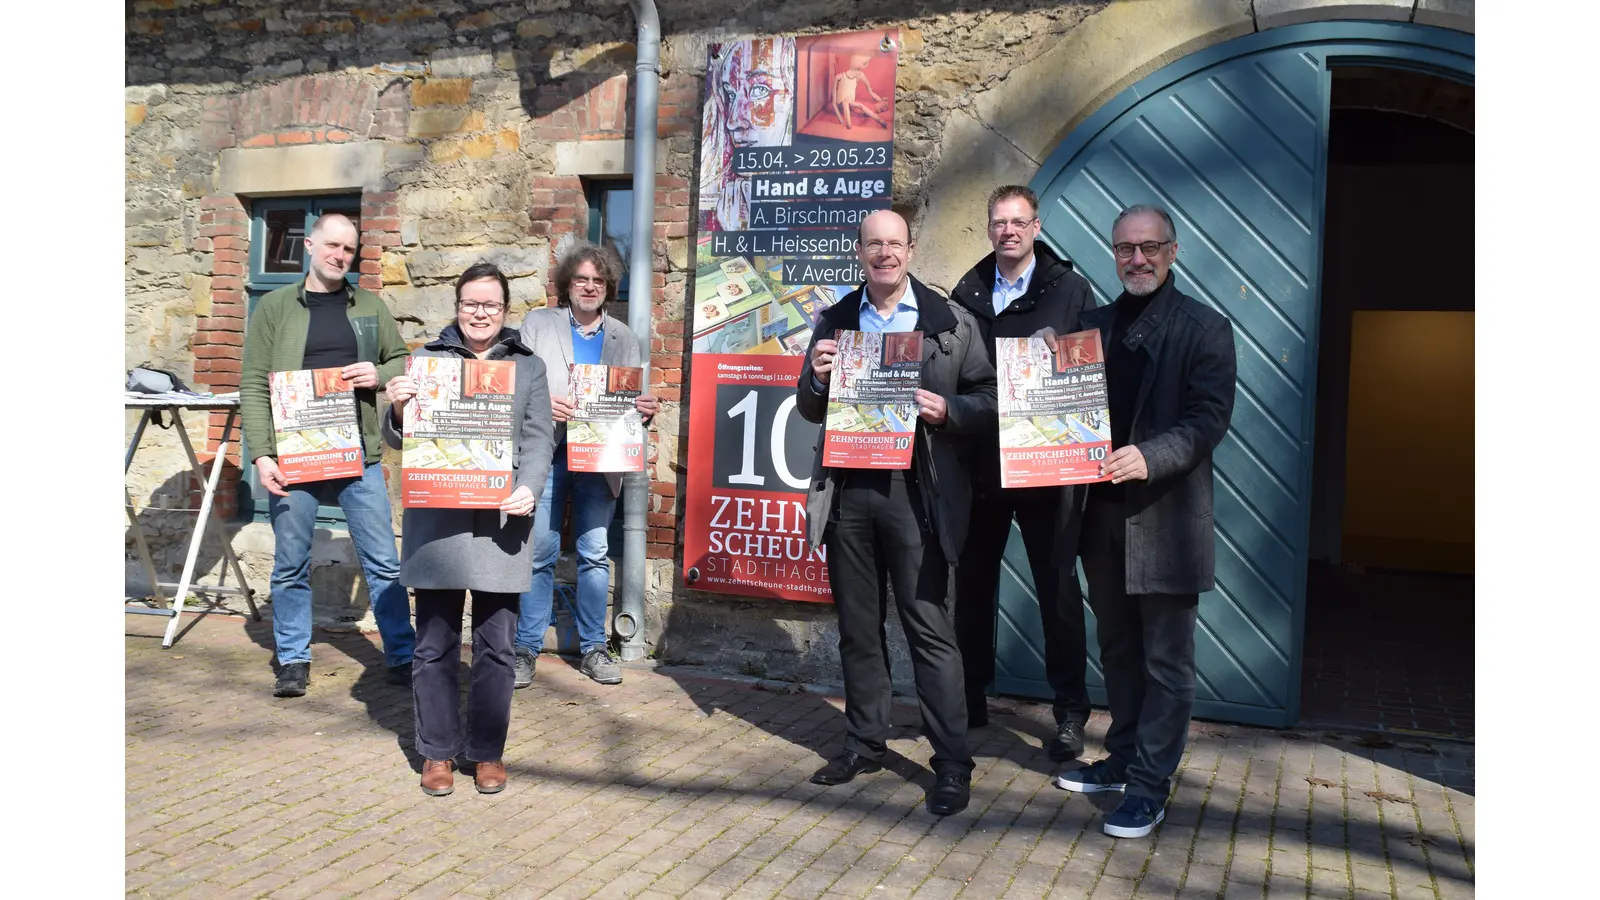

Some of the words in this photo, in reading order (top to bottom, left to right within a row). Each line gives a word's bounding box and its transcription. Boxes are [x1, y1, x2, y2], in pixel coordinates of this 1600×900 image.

[738, 152, 788, 170] 15.04.
[810, 147, 886, 167] 29.05.23
[756, 178, 808, 196] Hand
[814, 179, 828, 195] &
[834, 177, 885, 198] Auge
[754, 208, 769, 224] A.
[715, 236, 731, 253] H.
[736, 236, 748, 253] &
[753, 236, 766, 253] L.
[772, 233, 858, 253] Heissenb
[786, 264, 797, 282] Y.
[802, 263, 866, 282] Averdie
[718, 363, 764, 372] Öffnungszeiten:
[900, 370, 919, 379] Auge
[1045, 376, 1069, 386] Hand
[1072, 375, 1079, 383] &
[1080, 372, 1103, 382] Auge
[452, 401, 477, 409] Hand
[488, 403, 512, 412] Auge
[830, 435, 894, 444] ZEHNTSCHEUNE
[1006, 448, 1085, 460] ZEHNTSCHEUNE
[1032, 457, 1086, 466] STADTHAGEN
[408, 473, 486, 482] ZEHNTSCHEUNE
[710, 496, 806, 534] ZEHN
[708, 530, 826, 562] SCHEUN
[707, 556, 830, 582] STADTHAGE
[707, 577, 832, 594] www.zehntscheune-stadthagen
